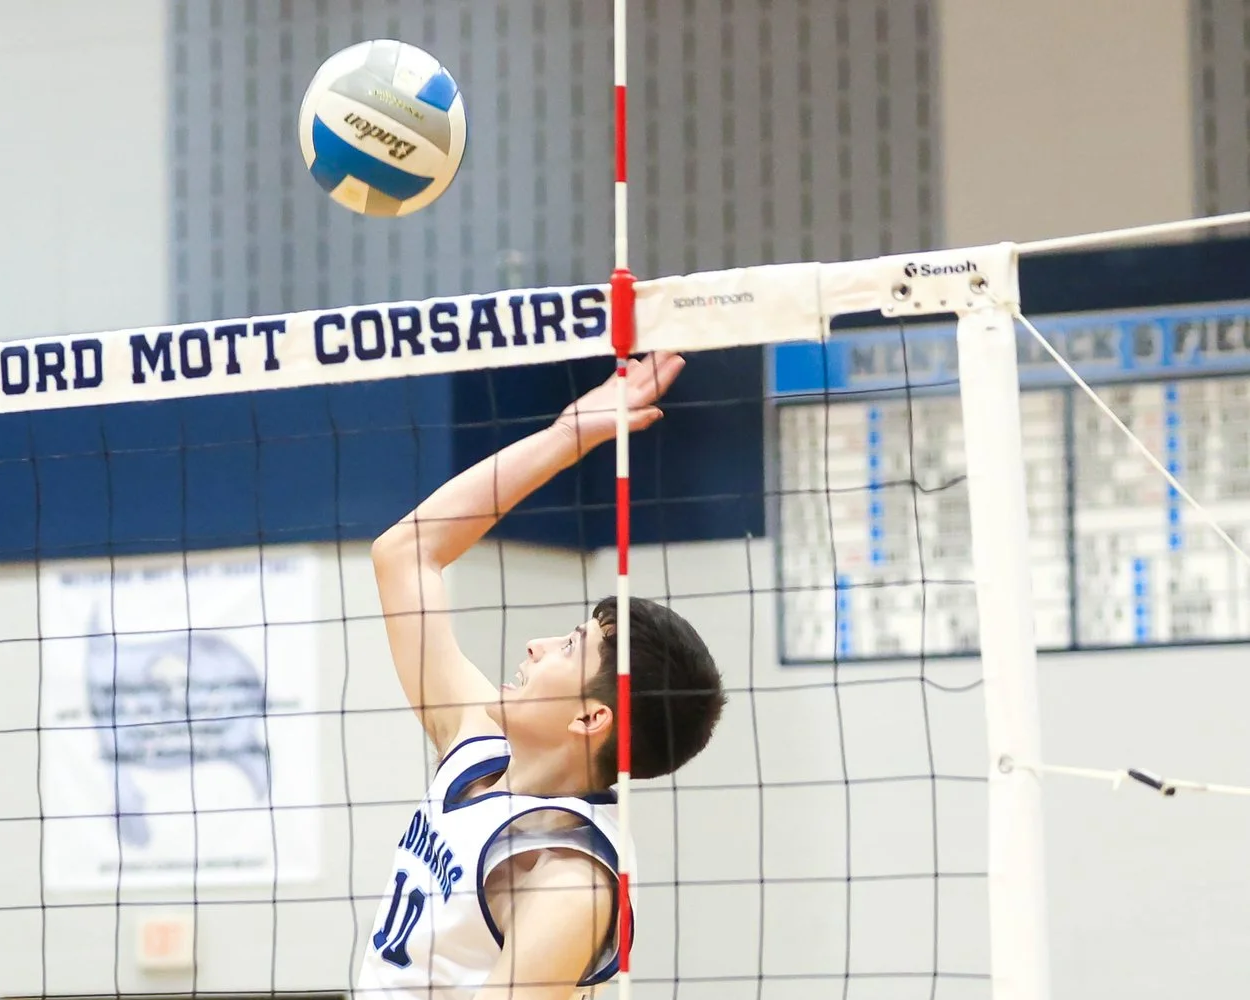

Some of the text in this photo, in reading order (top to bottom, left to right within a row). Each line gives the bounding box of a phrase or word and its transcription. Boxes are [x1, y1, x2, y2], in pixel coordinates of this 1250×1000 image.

[920, 260, 978, 277] Senoh
[130, 319, 287, 384] MOTT
[314, 287, 608, 365] CORSAIRS
[398, 809, 463, 904] ORSAIRS
[373, 869, 426, 969] 10
